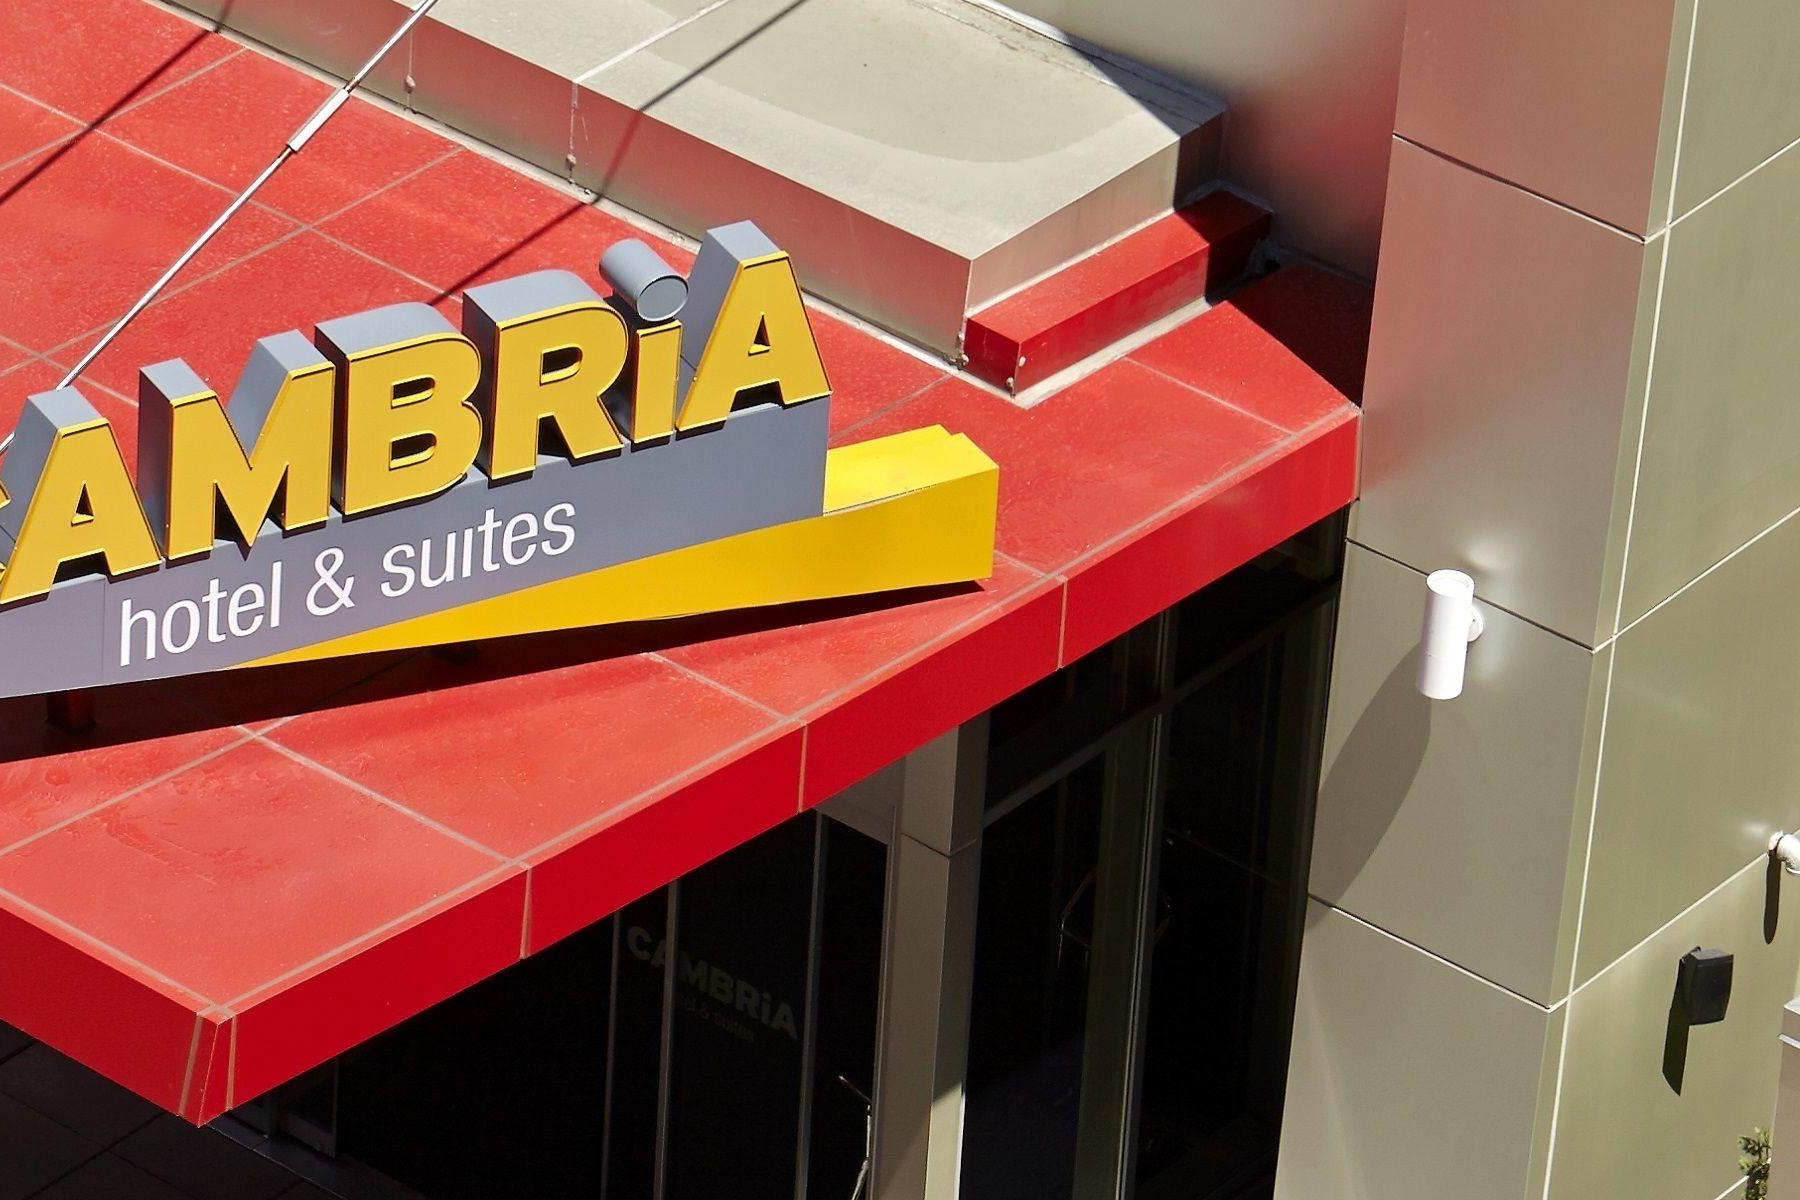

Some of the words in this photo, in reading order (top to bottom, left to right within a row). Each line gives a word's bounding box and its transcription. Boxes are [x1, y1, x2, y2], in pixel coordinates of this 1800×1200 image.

[117, 560, 283, 667] hotel
[305, 545, 357, 618] &
[379, 501, 576, 599] suites
